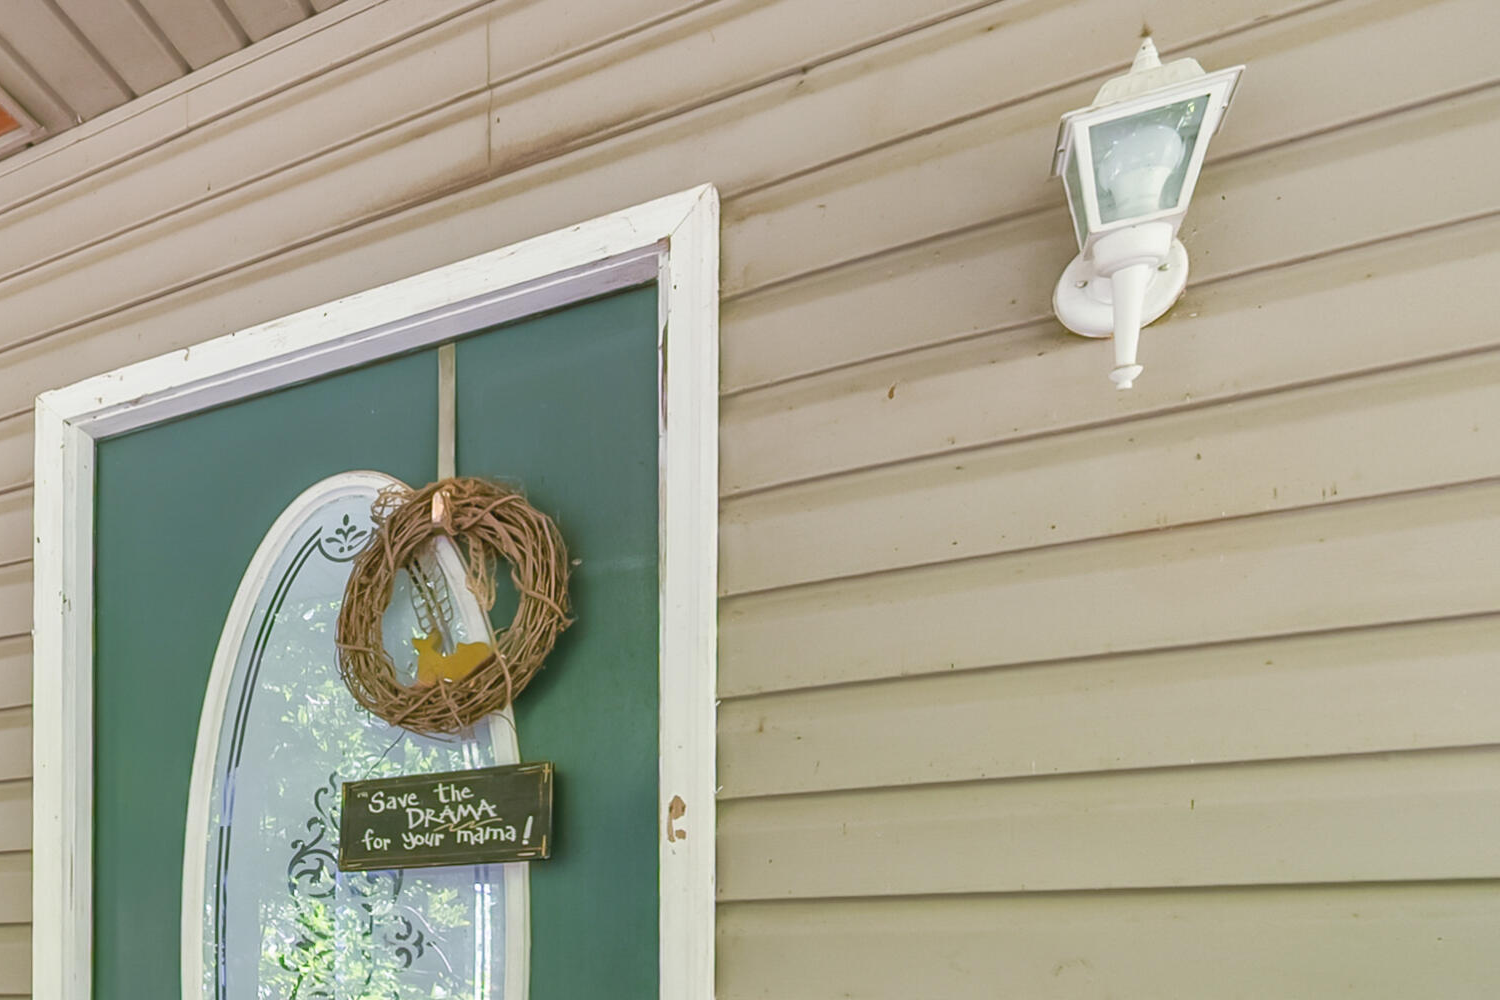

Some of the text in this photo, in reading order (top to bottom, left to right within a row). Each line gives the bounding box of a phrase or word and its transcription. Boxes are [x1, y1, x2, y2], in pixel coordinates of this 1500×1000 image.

[368, 783, 474, 813] Save the
[406, 799, 497, 829] DRAMA
[361, 829, 391, 851] for
[401, 831, 444, 850] your
